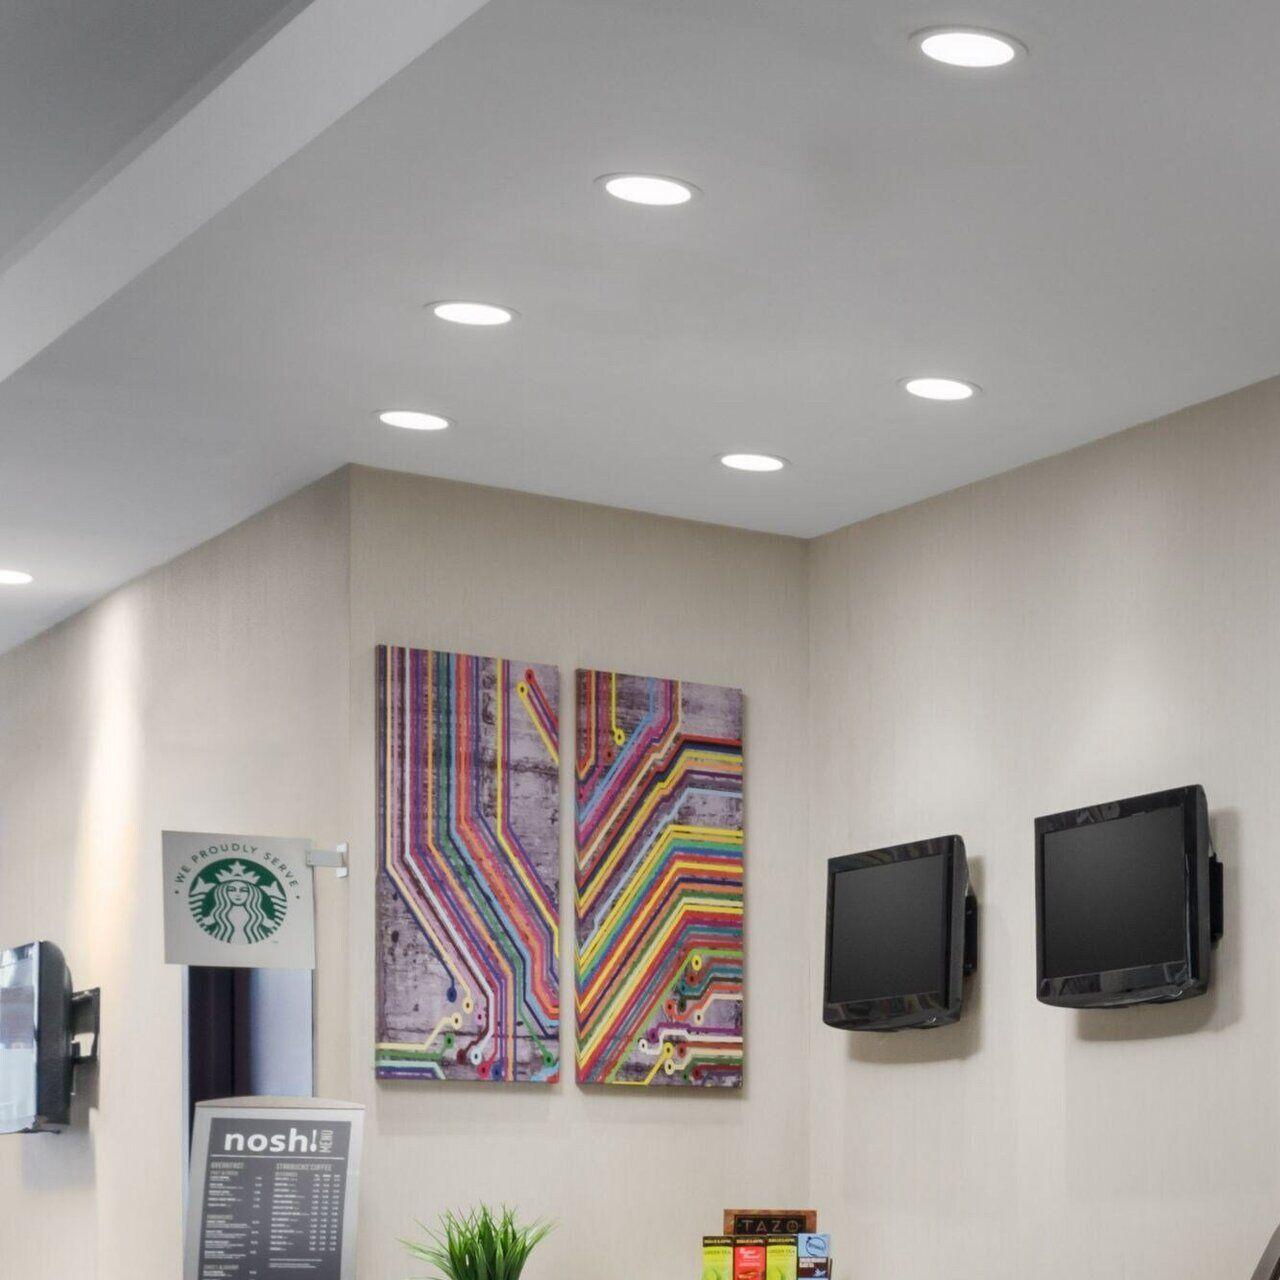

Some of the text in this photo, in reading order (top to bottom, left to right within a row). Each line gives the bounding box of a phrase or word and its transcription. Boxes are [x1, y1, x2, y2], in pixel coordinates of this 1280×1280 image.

[175, 843, 299, 888] WE PROUDLY SERVE
[224, 1128, 317, 1153] nosh!
[320, 1129, 334, 1153] MENU
[741, 1218, 800, 1234] TAZO
